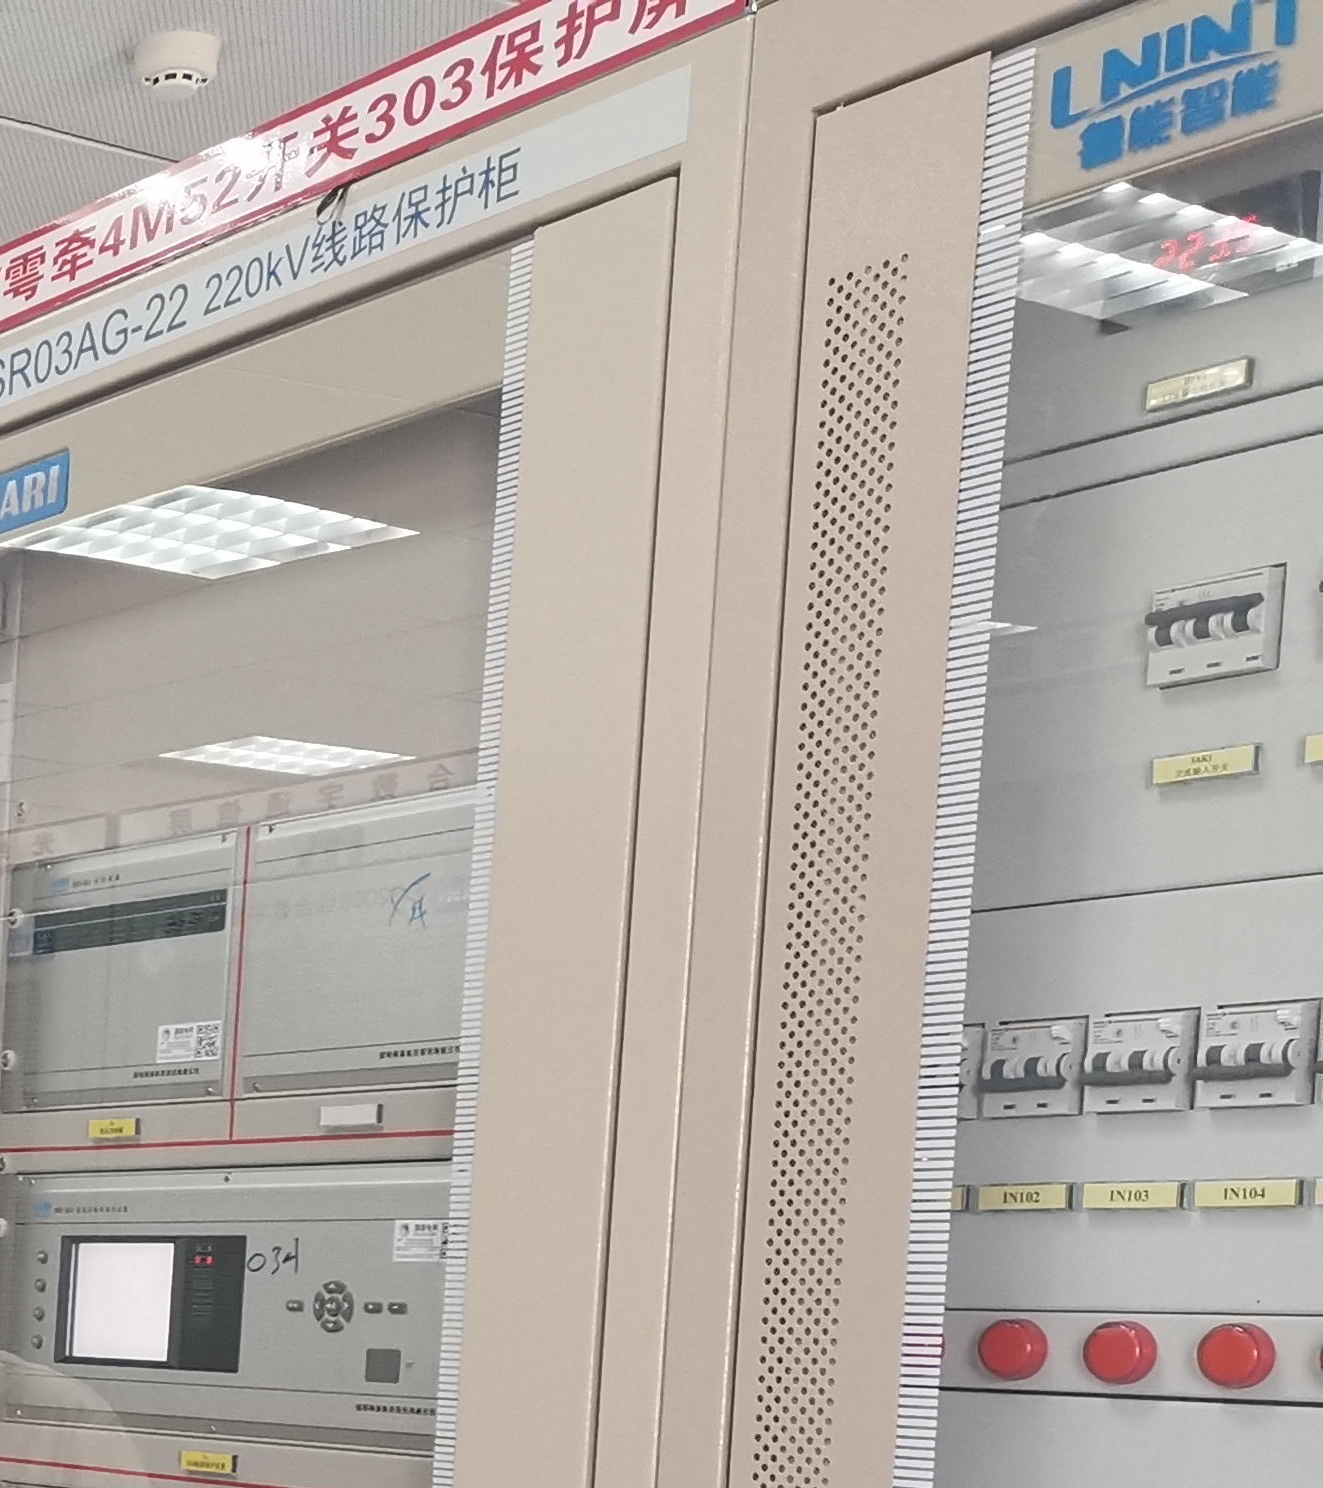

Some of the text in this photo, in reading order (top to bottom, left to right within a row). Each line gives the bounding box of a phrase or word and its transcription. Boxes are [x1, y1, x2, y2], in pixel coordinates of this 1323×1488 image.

[204, 147, 523, 317] 220kV线路保护柜
[1002, 1190, 1041, 1204] IN102
[1109, 1189, 1150, 1203] IN103
[1223, 1187, 1267, 1200] IN104
